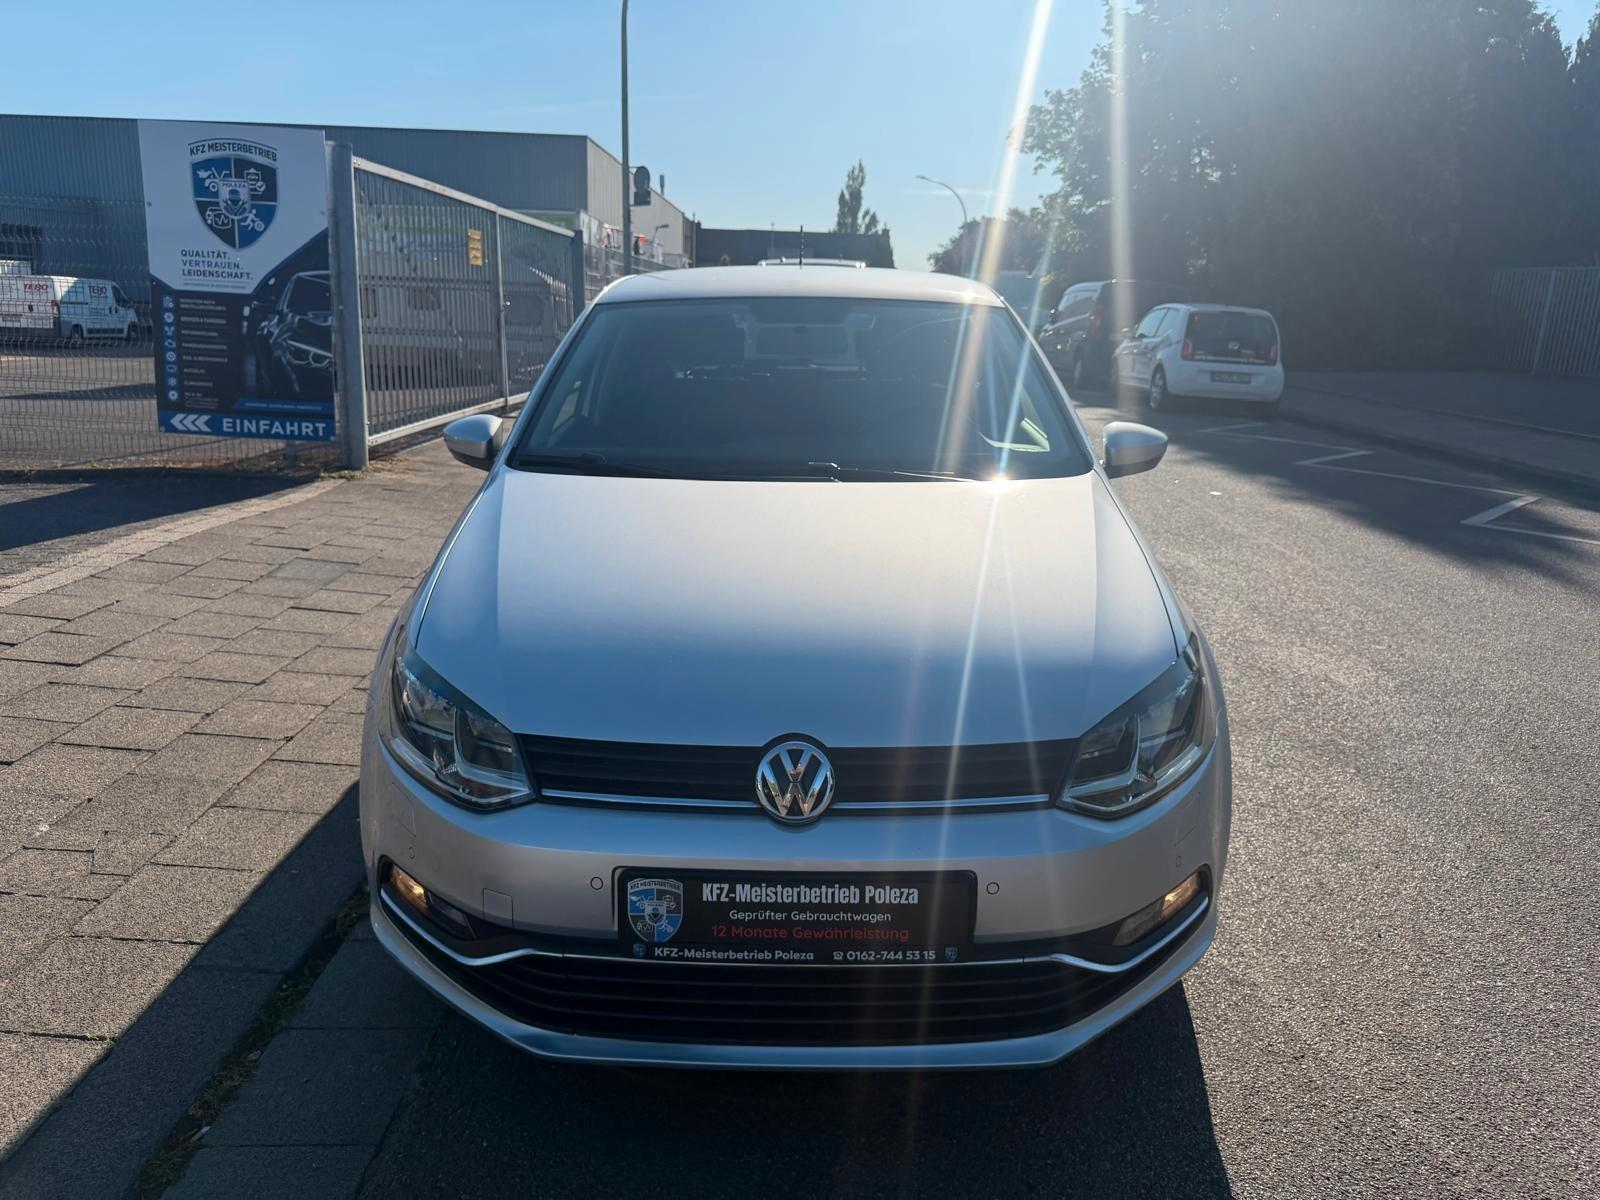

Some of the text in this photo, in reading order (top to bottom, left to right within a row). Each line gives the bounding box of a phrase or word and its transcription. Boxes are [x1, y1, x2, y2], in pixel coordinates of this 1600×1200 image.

[190, 142, 278, 162] KFZ MEISTERBETRIEB
[180, 249, 231, 261] QUALITÄT.
[181, 259, 244, 271] VERTRAUEN.
[182, 268, 254, 281] LEIDENSCHAFT.
[222, 417, 327, 437] EINFAHRT
[702, 882, 919, 905] KFZ-Meisterbetrieb Poleza
[729, 909, 892, 924] Geprüfter Gebrauchtwagen
[711, 925, 910, 943] 12 Monate Gewährleistung
[654, 947, 937, 961] KFZ-Meisterbetrieb Poleza 0162-744 53 15
